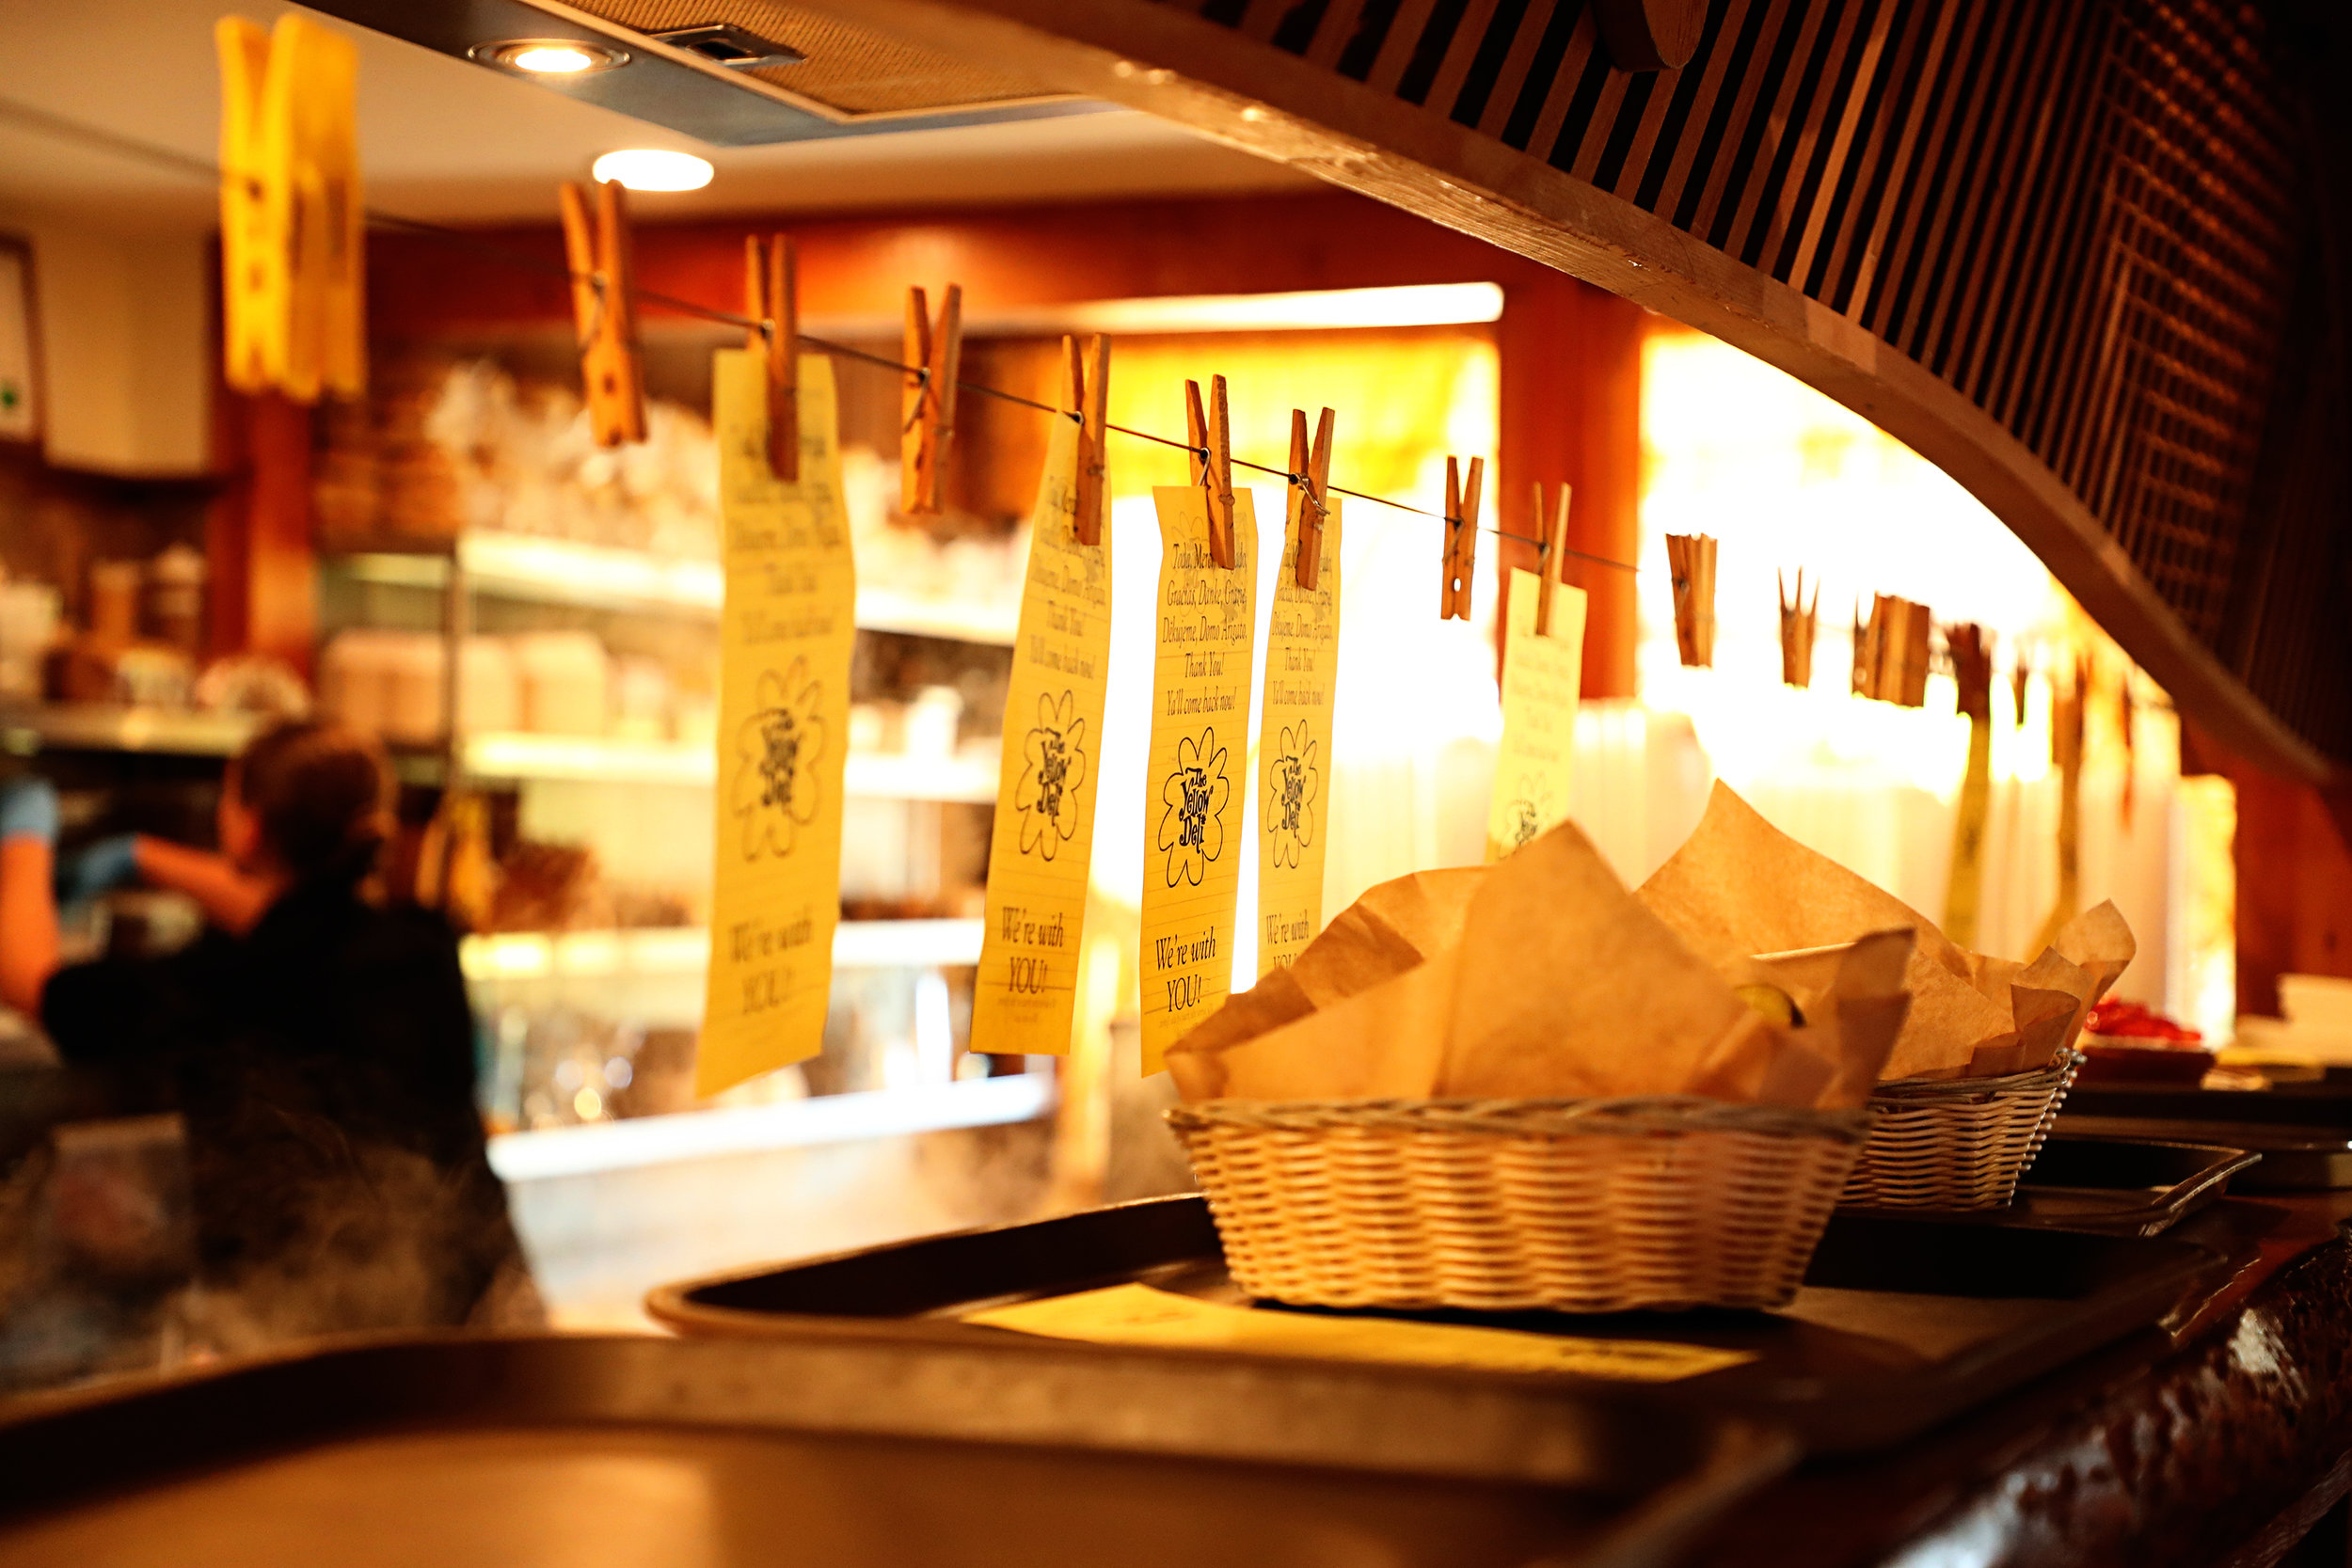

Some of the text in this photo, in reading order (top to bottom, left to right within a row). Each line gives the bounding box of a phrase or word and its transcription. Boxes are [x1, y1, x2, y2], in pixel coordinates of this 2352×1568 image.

[1167, 579, 1197, 610] Gracias,
[1198, 578, 1223, 609] Danke,
[1200, 616, 1220, 641] Domo
[1184, 650, 1225, 677] Thank You!
[1284, 646, 1302, 671] Thank
[1168, 686, 1237, 716] Ya'll come back now!
[1184, 767, 1207, 788] The
[1285, 755, 1301, 775] The
[1179, 778, 1214, 822] Yellow
[1281, 768, 1306, 806] Yellow
[1179, 813, 1206, 854] Deli
[1281, 800, 1301, 838] Deli
[1002, 906, 1064, 948] We're with
[1266, 909, 1310, 945] We're with
[1155, 926, 1216, 971] We're with
[1008, 956, 1048, 994] YOU!
[1167, 974, 1201, 1012] YOU!
